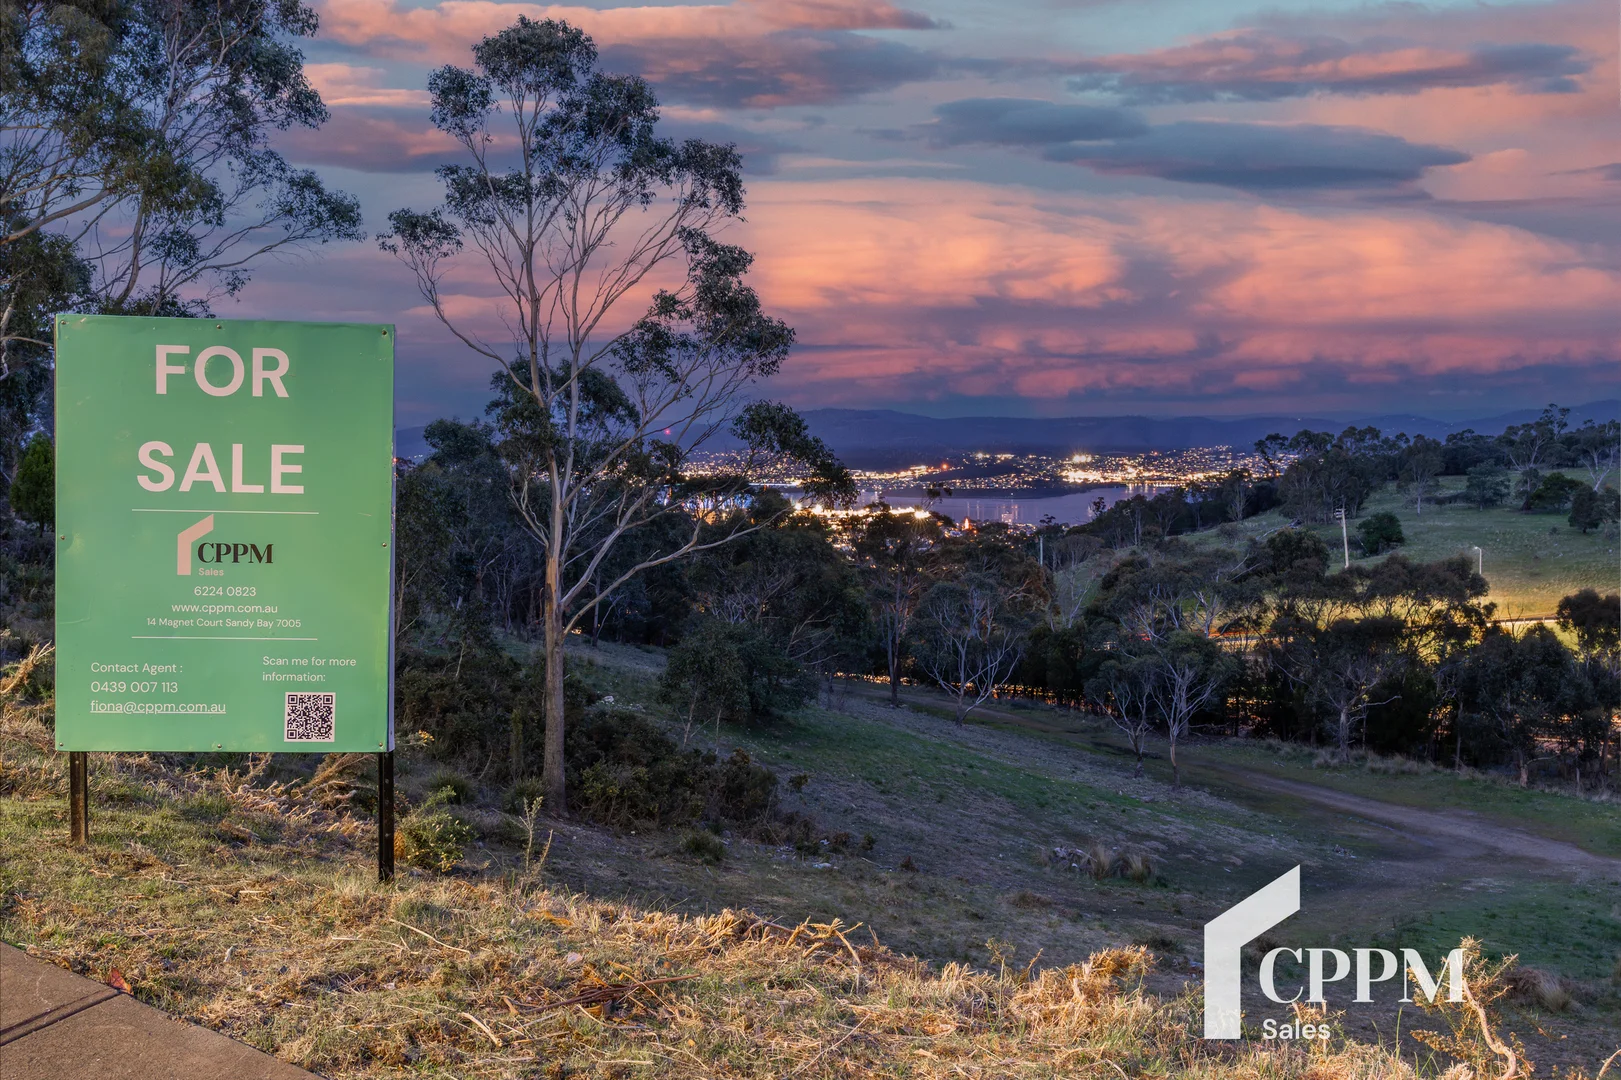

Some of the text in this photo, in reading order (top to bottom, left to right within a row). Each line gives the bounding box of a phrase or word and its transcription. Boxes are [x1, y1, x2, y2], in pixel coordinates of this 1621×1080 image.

[155, 344, 290, 398] FOR
[136, 440, 305, 495] SALE
[197, 542, 274, 564] CPPM
[198, 567, 225, 577] Sales
[193, 586, 257, 597] 6224 0823
[171, 604, 278, 615] www.cppm.com.au
[146, 617, 301, 629] 14 Magnet Court Sandy Bay 7005
[262, 656, 357, 666] Scan me for more
[91, 662, 139, 673] Contact
[262, 672, 326, 682] information:
[91, 681, 178, 693] 0439 007 113
[90, 700, 226, 715] fiona@cppm.com.au
